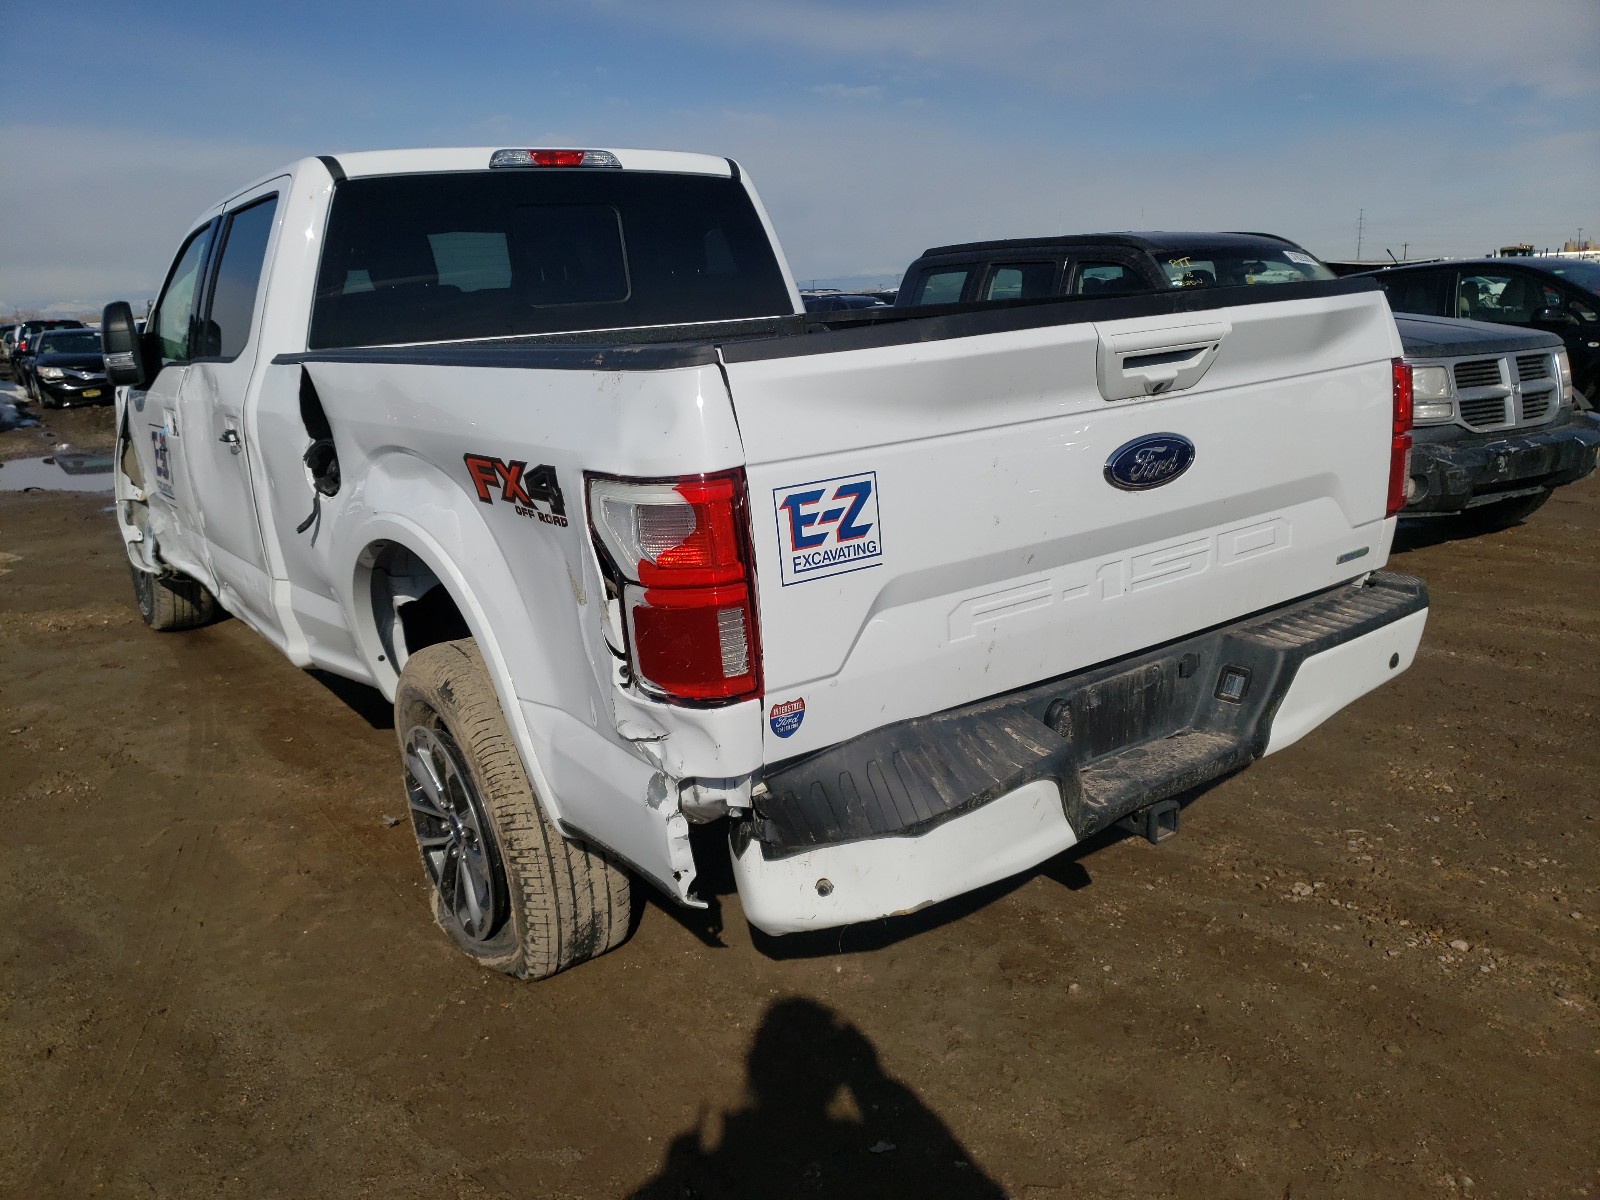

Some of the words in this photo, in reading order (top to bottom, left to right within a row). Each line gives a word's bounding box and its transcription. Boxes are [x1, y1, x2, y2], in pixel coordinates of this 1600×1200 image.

[1129, 446, 1179, 481] Ford
[463, 452, 566, 517] FX4
[514, 505, 536, 519] OFF
[537, 511, 568, 528] ROAD
[779, 480, 873, 552] E-Z
[793, 541, 877, 574] EXCAVATING
[947, 517, 1292, 643] F-150
[775, 713, 800, 728] Ford
